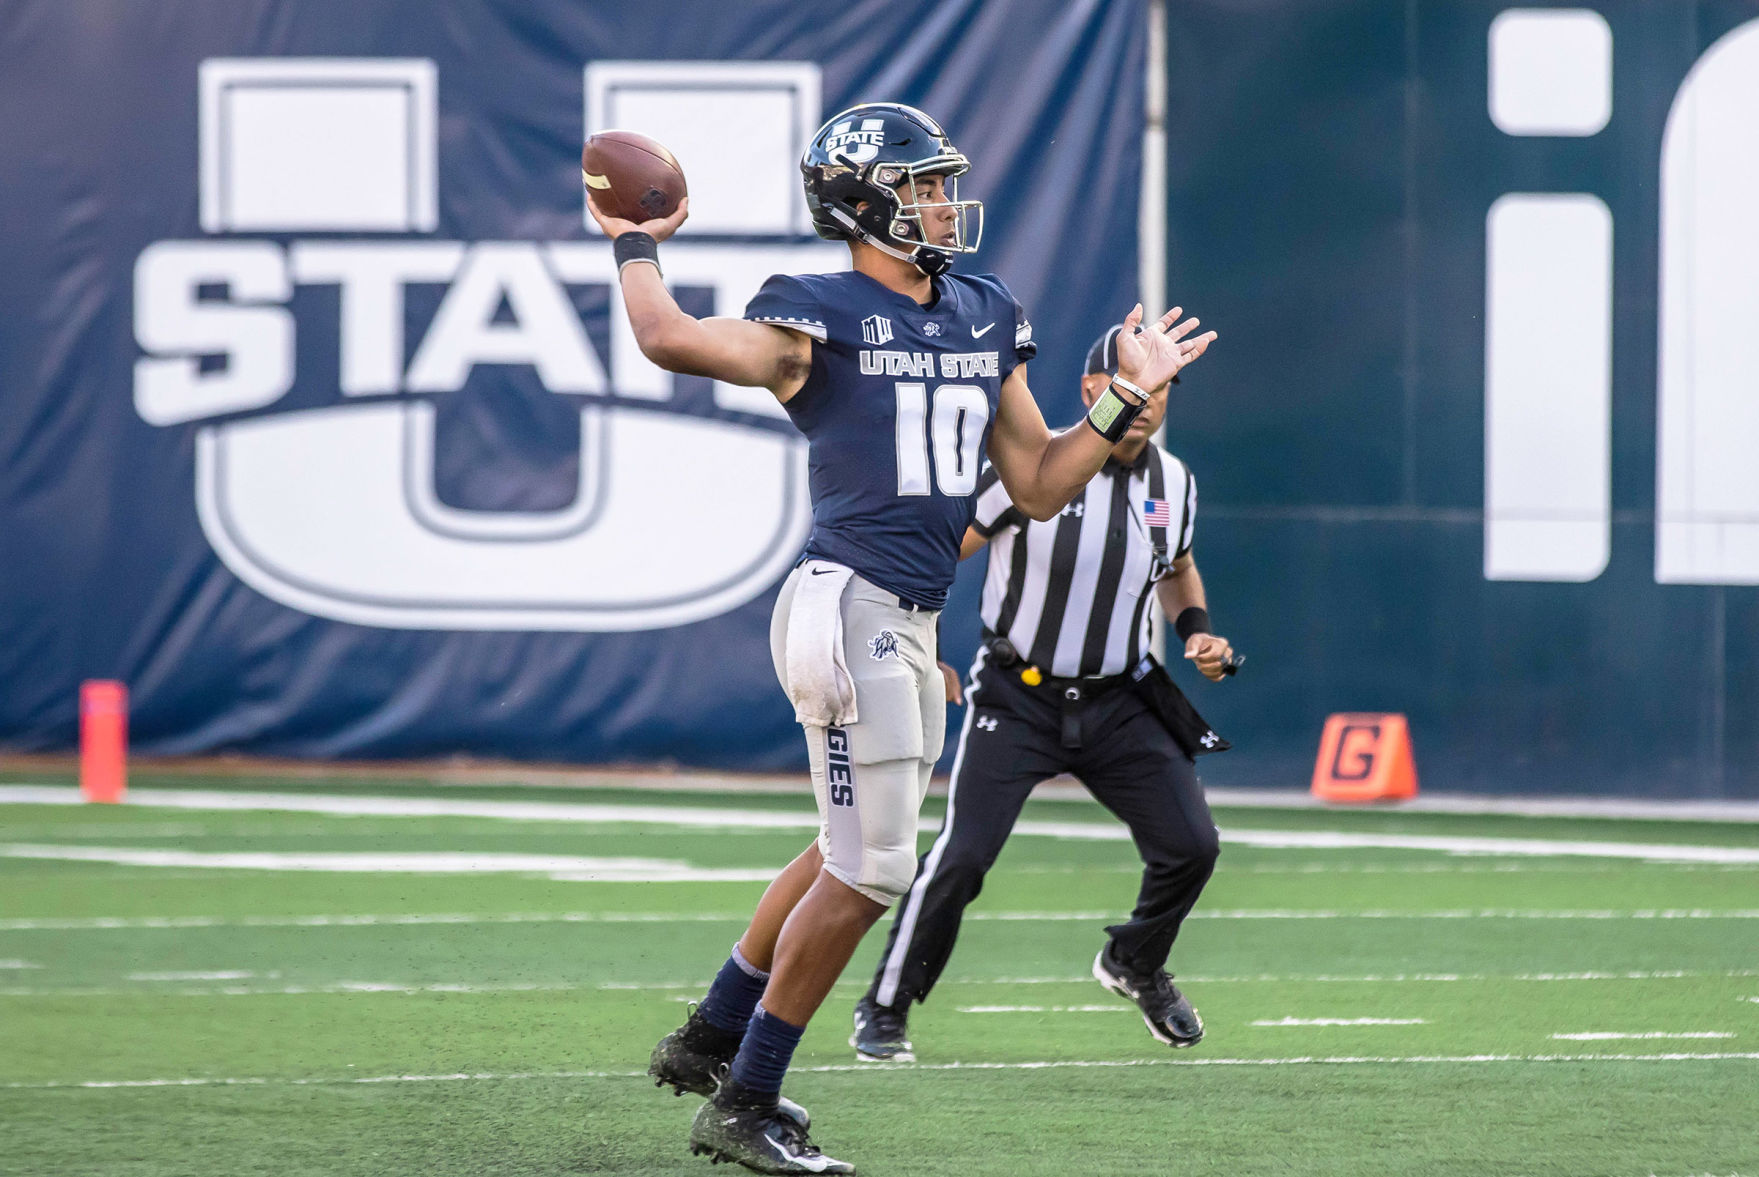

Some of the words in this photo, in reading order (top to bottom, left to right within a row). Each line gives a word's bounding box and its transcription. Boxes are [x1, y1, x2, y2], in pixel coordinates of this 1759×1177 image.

[825, 131, 885, 153] STATE
[859, 350, 935, 378] UTAH
[940, 351, 999, 378] STATE
[895, 382, 989, 496] 10
[827, 725, 854, 807] GIES
[1331, 725, 1381, 780] G
